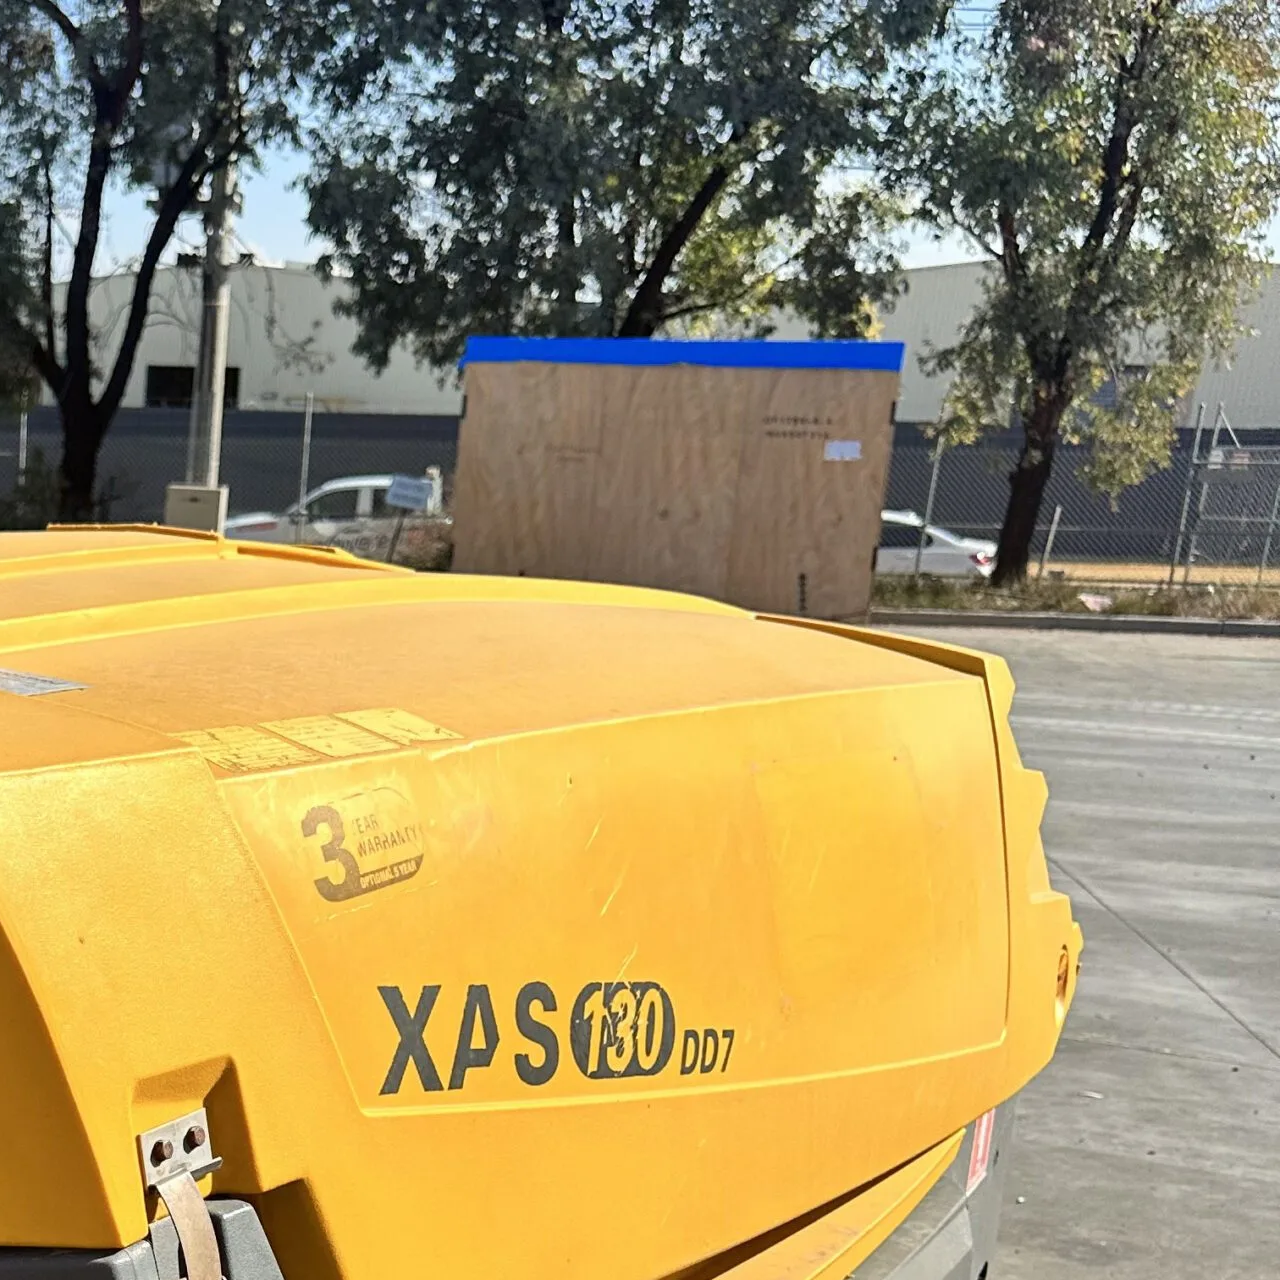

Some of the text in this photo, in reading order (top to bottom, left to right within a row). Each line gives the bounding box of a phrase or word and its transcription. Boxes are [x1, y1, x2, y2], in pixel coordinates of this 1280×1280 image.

[301, 805, 361, 902] 3
[377, 981, 560, 1096] XAS
[679, 1028, 735, 1075] DD7
